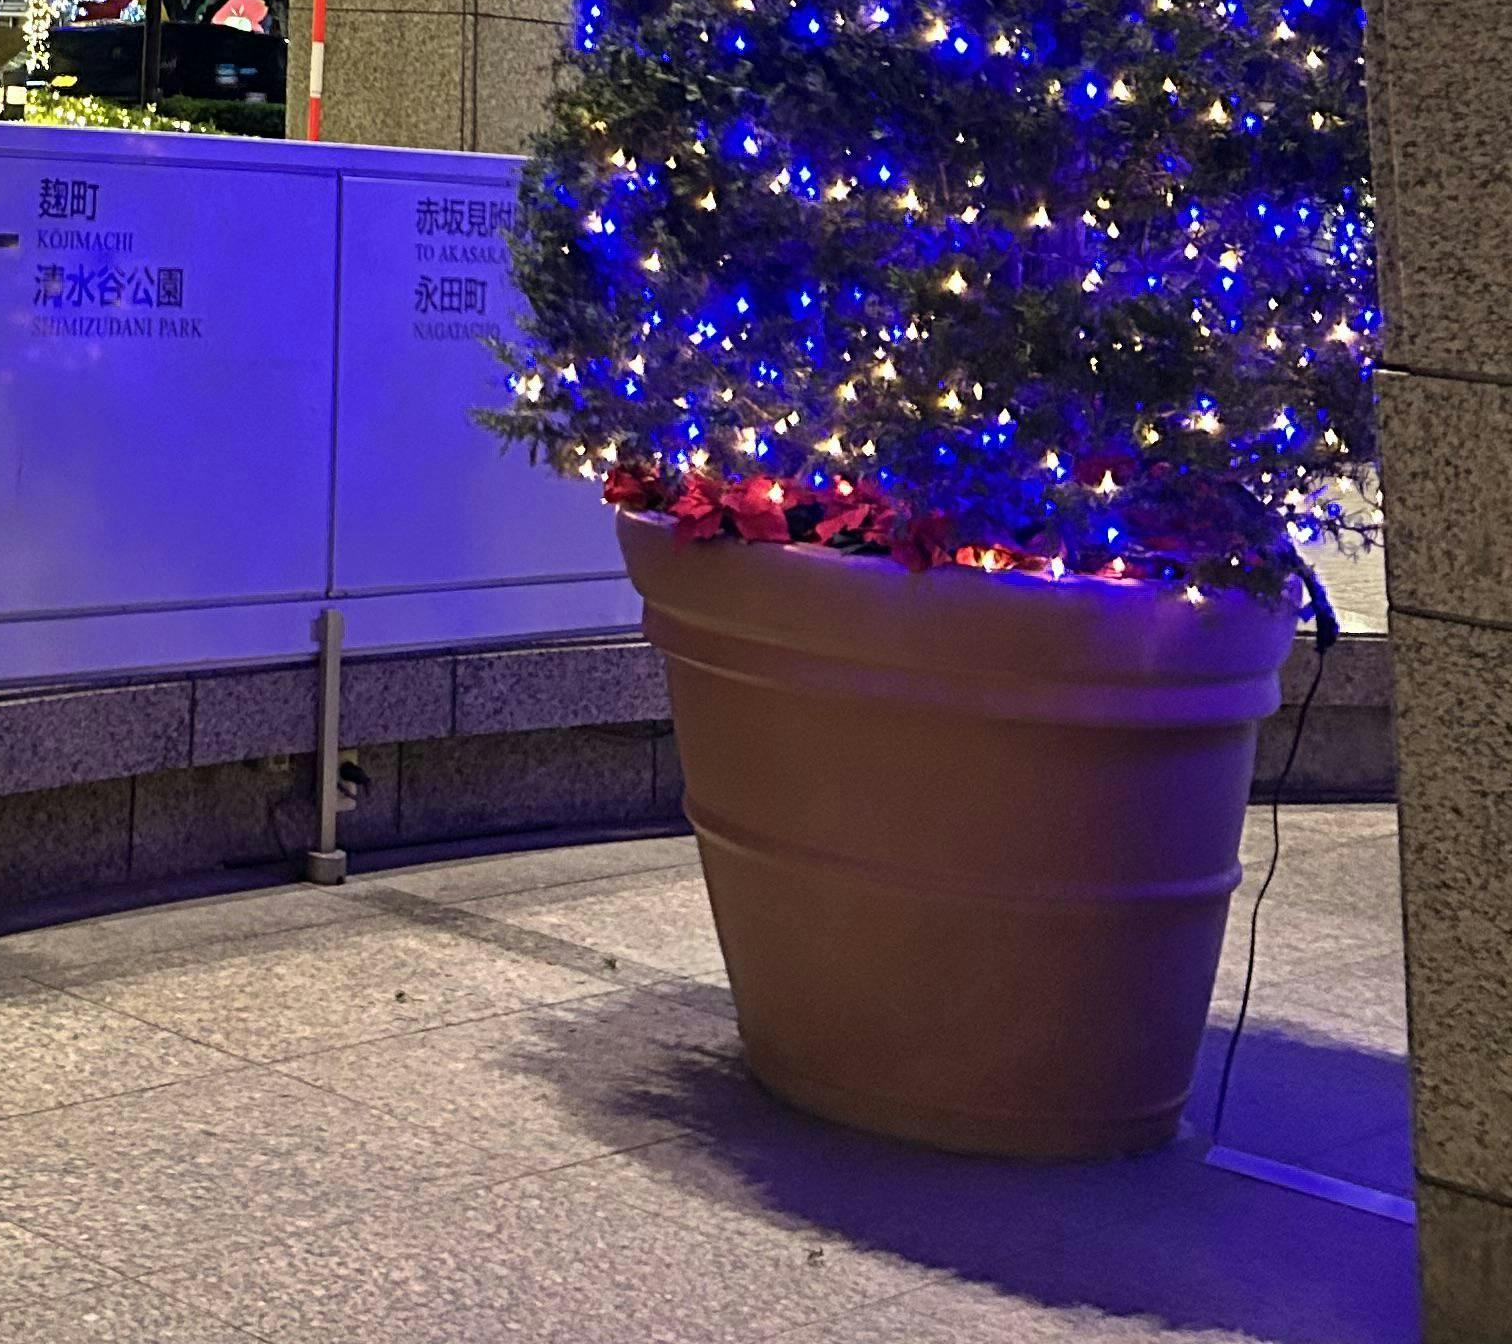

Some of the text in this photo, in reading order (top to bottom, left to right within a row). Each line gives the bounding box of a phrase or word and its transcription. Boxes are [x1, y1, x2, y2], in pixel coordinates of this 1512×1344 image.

[416, 197, 519, 237] 赤坂見附
[415, 243, 435, 261] TO
[34, 264, 184, 308] 清水谷公園
[415, 274, 487, 315] 永田町
[31, 315, 203, 338] SHIMIZUDANI PARK
